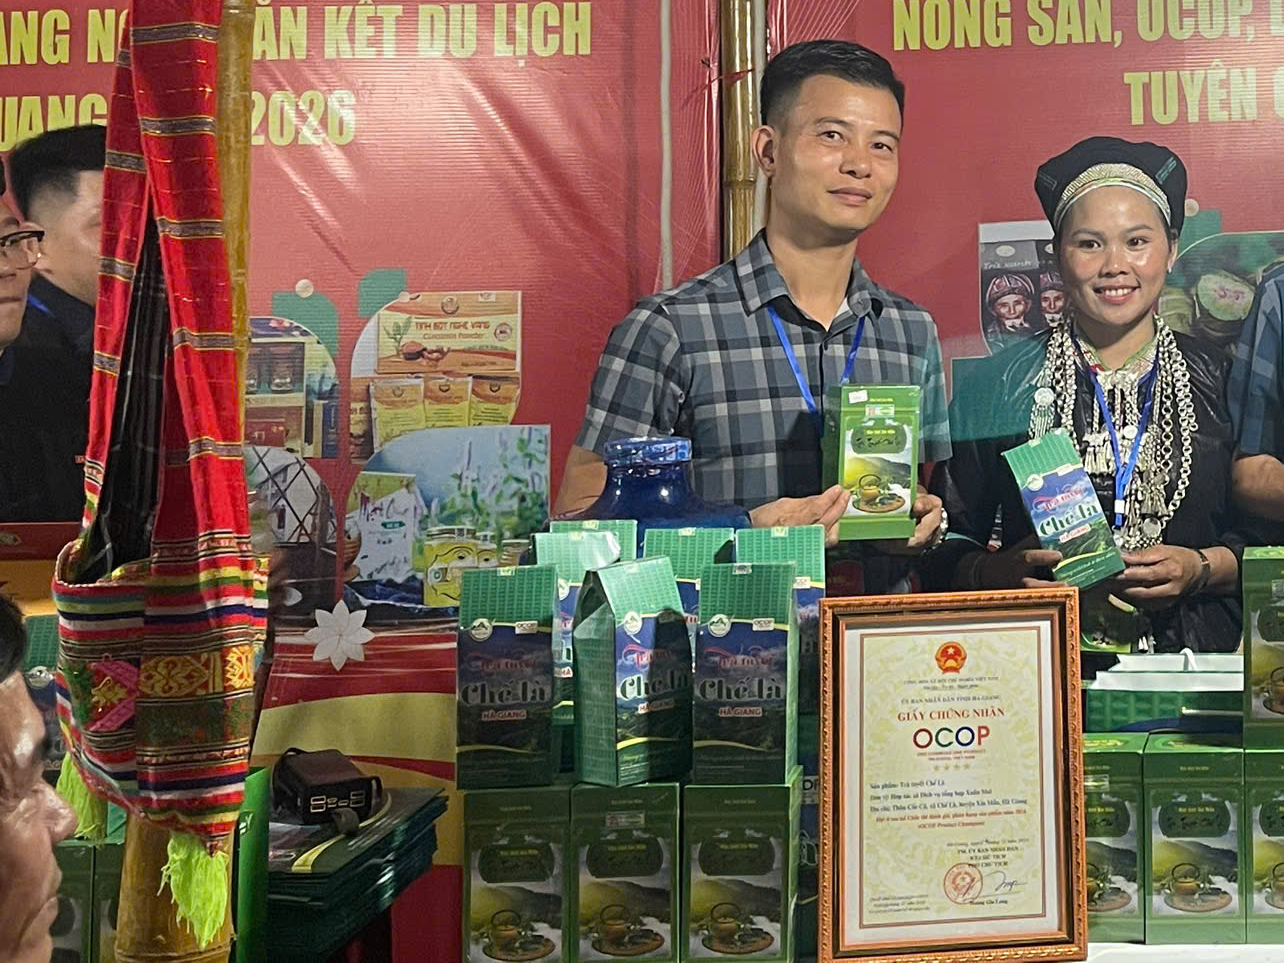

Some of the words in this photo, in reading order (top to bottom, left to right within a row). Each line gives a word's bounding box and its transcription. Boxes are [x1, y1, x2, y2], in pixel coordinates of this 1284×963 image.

[418, 4, 477, 58] DU
[493, 1, 592, 67] LỊCH
[1124, 61, 1257, 126] TUYÊN
[250, 90, 356, 147] 2026
[1040, 507, 1073, 535] Chế
[1078, 501, 1098, 518] là
[461, 679, 514, 704] Chế
[521, 680, 546, 702] là
[700, 677, 750, 699] Chế
[758, 678, 781, 699] là
[720, 706, 731, 715] HÀ
[898, 708, 925, 721] GIẤY
[930, 708, 969, 720] CHỨNG
[973, 706, 1005, 719] NHẬN
[913, 725, 990, 749] OCOP
